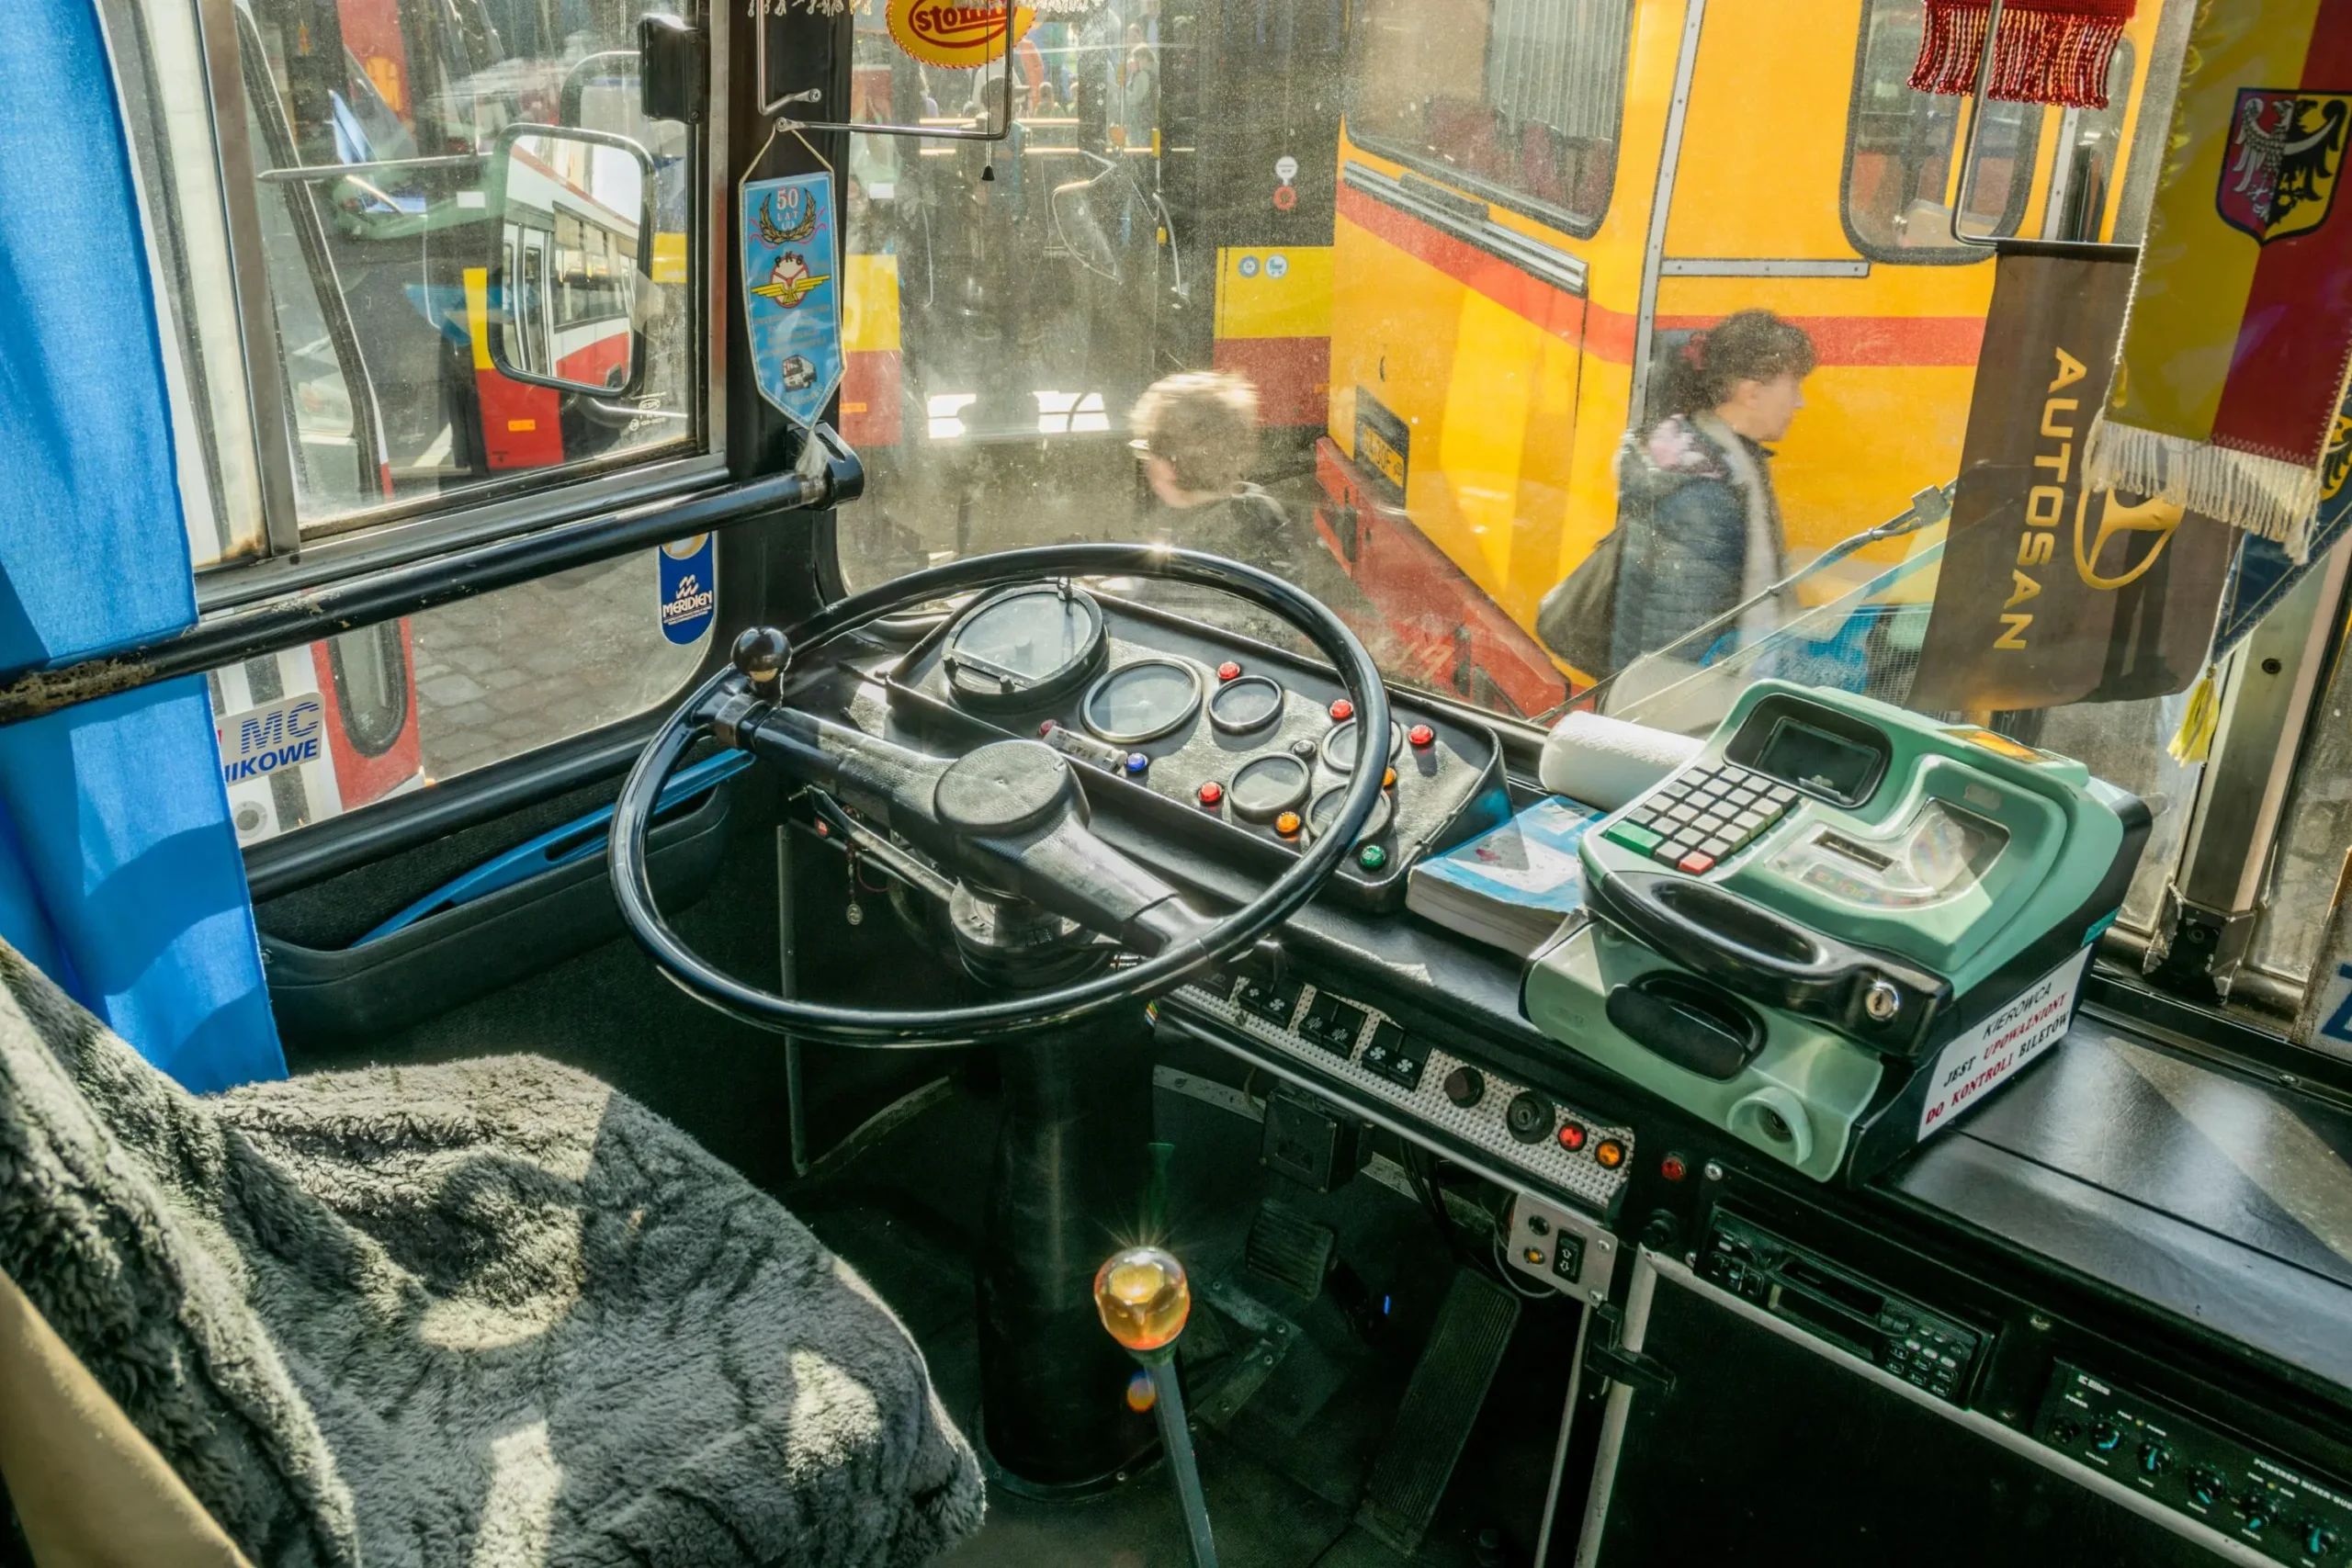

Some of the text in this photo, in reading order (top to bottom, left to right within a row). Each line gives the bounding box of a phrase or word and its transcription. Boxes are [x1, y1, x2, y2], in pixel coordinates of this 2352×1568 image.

[776, 187, 798, 210] 50
[777, 210, 798, 221] LAT
[1993, 346, 2087, 649] AUTOSAN
[662, 590, 713, 618] MERIDIEN
[241, 701, 320, 754] MC
[1983, 982, 2052, 1040] KIEROWCA
[1944, 992, 2067, 1088] JEST UPOWAŻNIONY
[1926, 1010, 2071, 1125] DO KONTROLI BILETÓW
[2253, 1457, 2301, 1484] POWERED
[2301, 1480, 2332, 1501] MIXER
